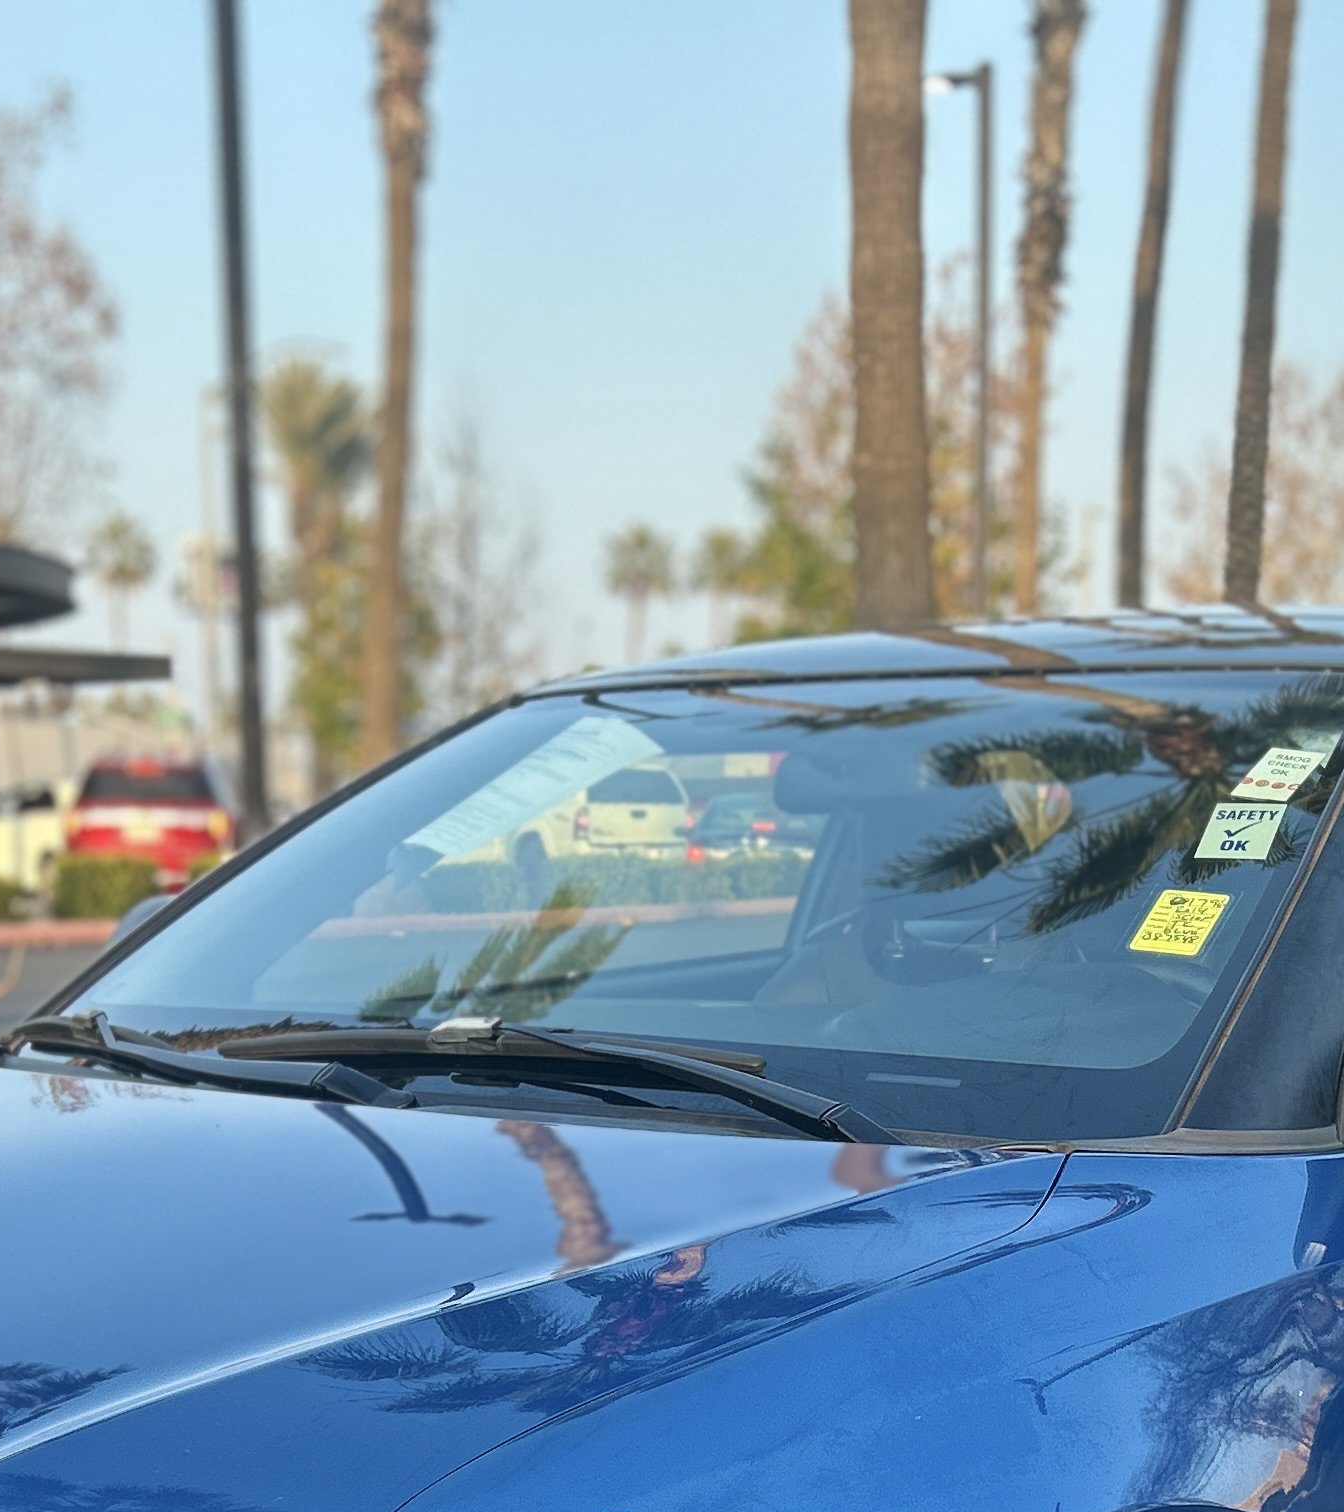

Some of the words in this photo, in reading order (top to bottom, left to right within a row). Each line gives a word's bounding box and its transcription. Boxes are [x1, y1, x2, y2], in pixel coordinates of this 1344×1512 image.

[1275, 753, 1312, 763] SMOG
[1267, 760, 1310, 770] CHECK
[1270, 768, 1290, 776] OK
[1216, 810, 1279, 821] SAFETY
[1219, 840, 1250, 851] OK
